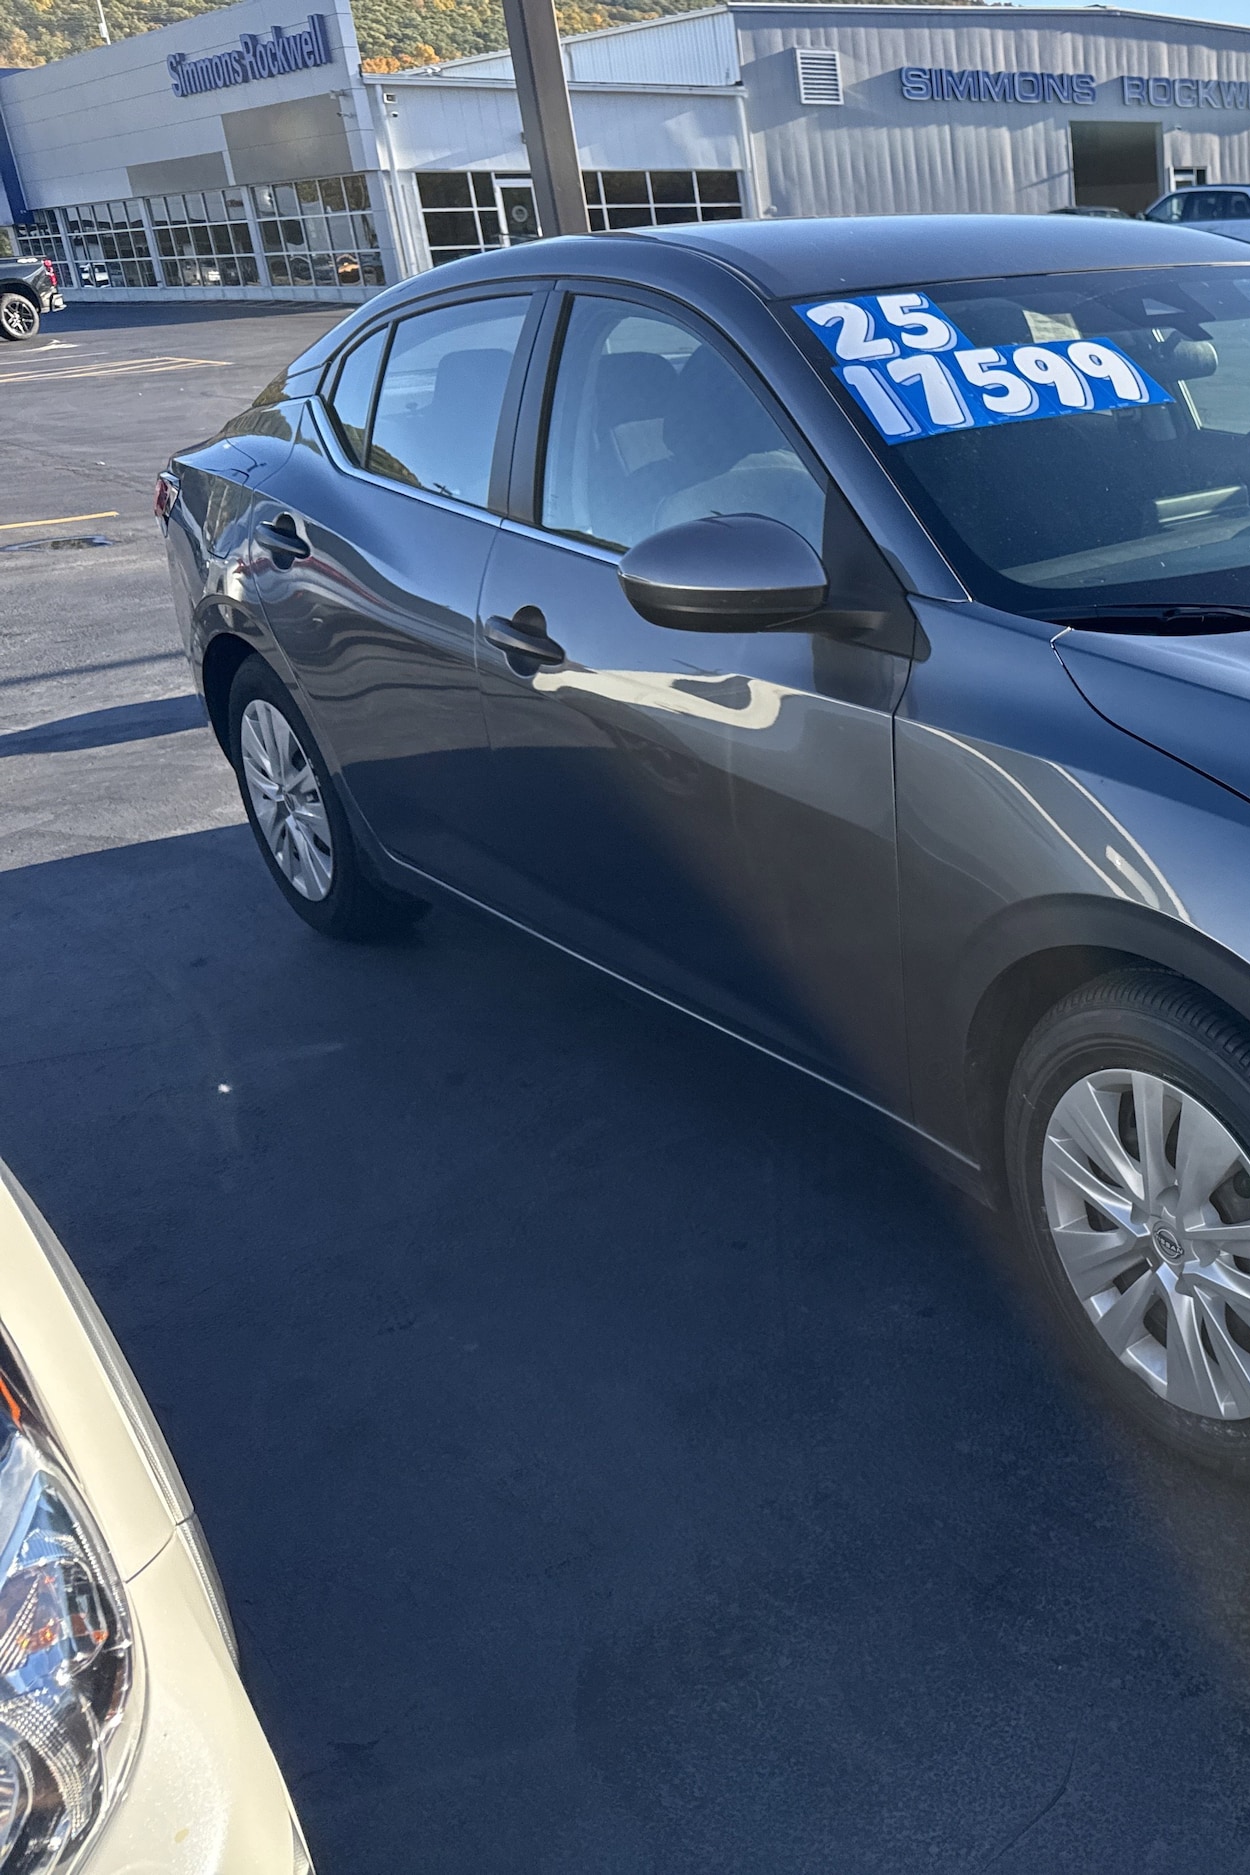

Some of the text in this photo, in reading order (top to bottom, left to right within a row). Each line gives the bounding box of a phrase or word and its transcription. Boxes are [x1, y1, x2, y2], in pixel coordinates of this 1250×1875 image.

[167, 14, 331, 97] Simmons Rockwell
[901, 66, 1097, 105] SIMMONS
[806, 292, 958, 361] 25
[842, 341, 1150, 437] 17599
